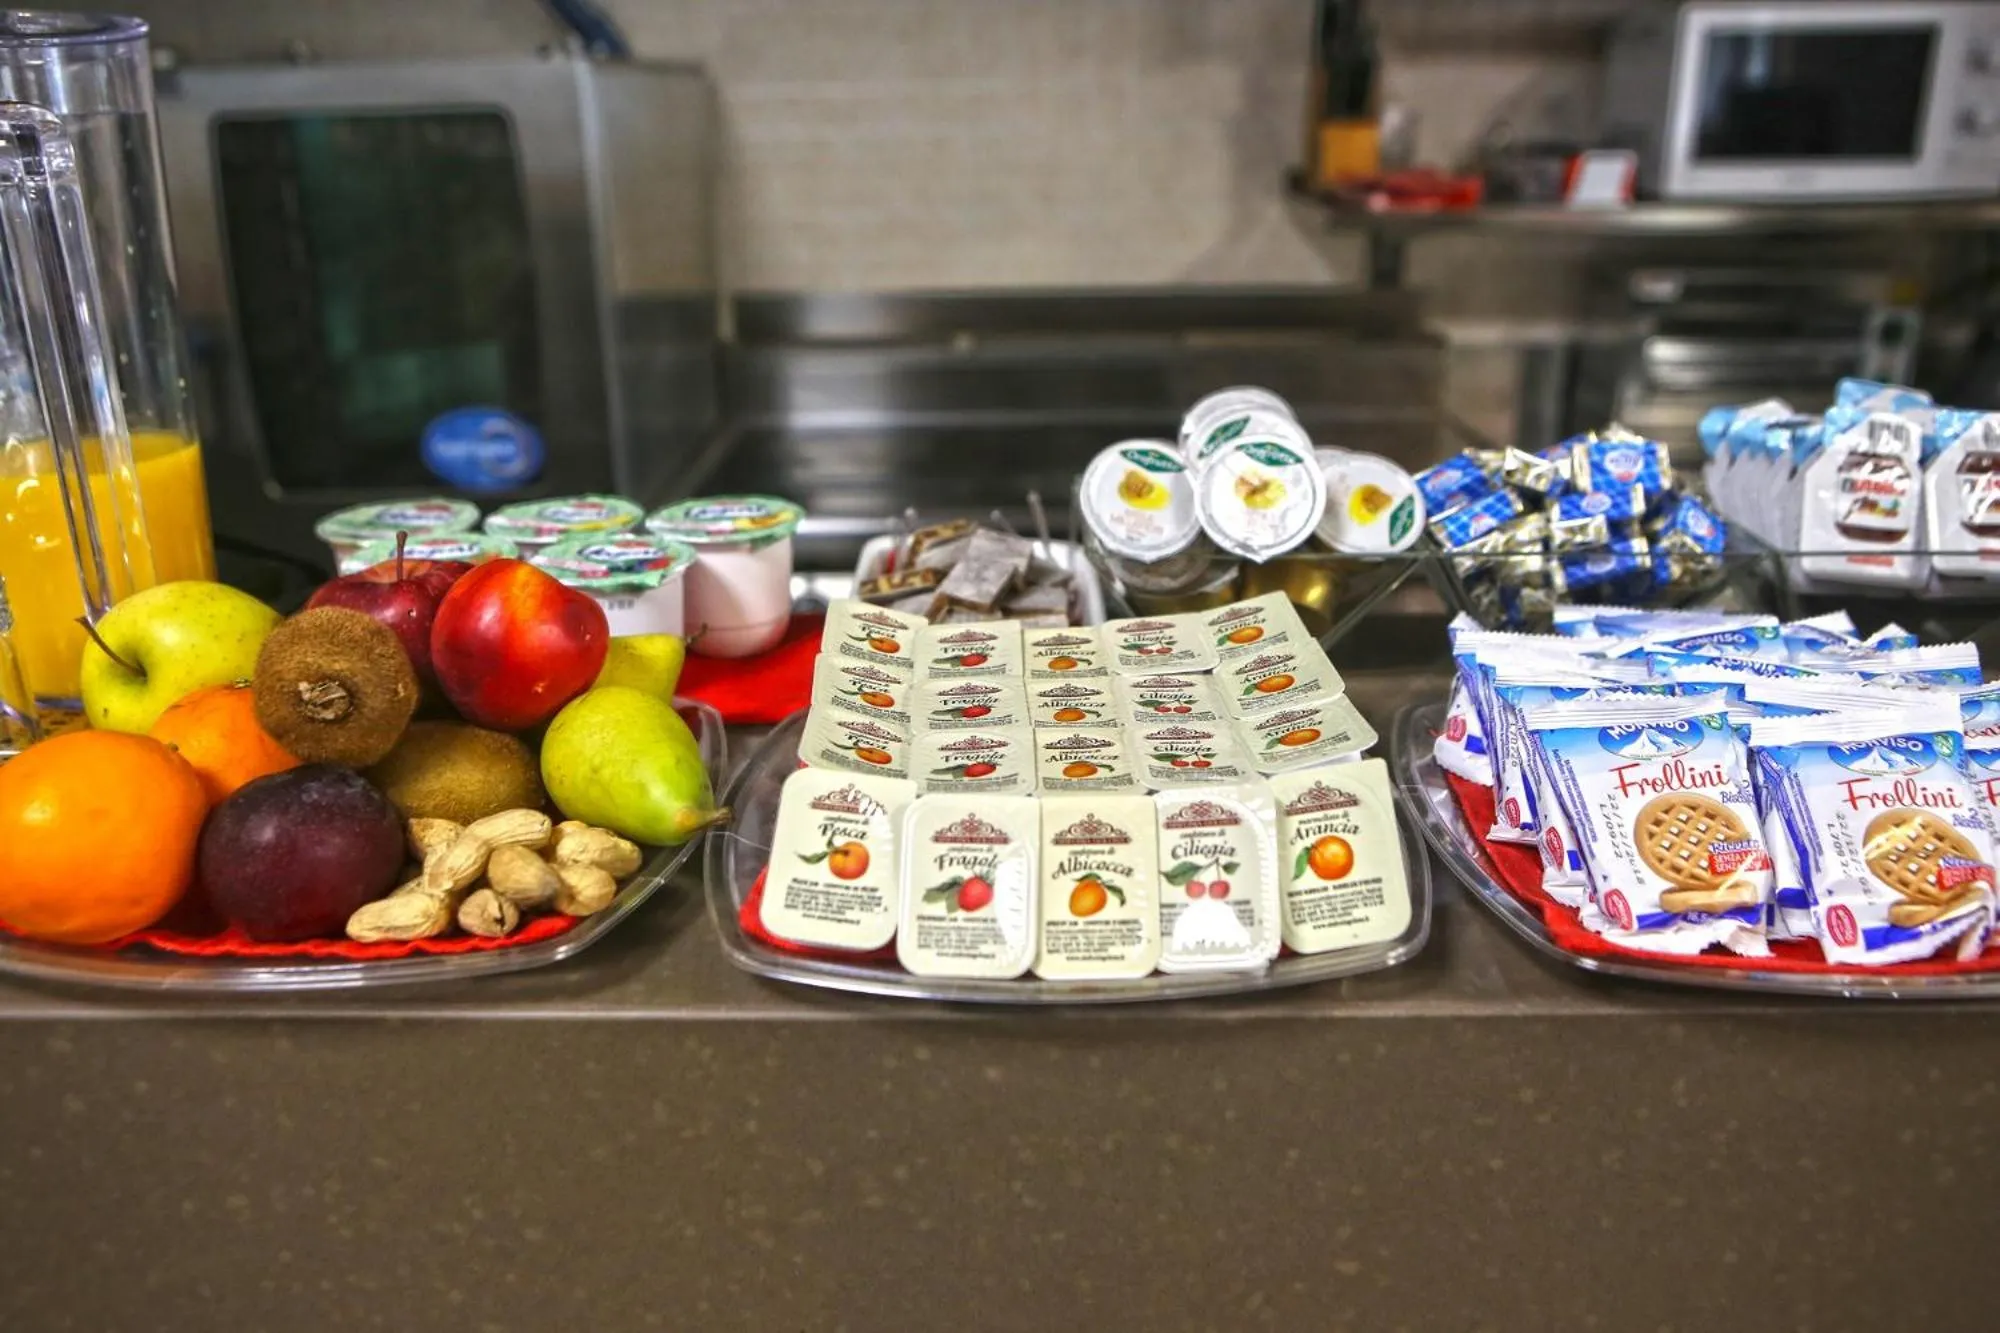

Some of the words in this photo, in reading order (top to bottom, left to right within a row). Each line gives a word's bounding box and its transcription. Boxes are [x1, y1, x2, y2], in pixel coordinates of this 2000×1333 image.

[1608, 759, 1730, 798] Frollini
[1836, 777, 1963, 811] Frollini
[817, 823, 868, 840] Pesca
[1290, 819, 1360, 846] Arancia
[1170, 836, 1236, 860] Ciliegia
[1052, 856, 1134, 879] Albicocca
